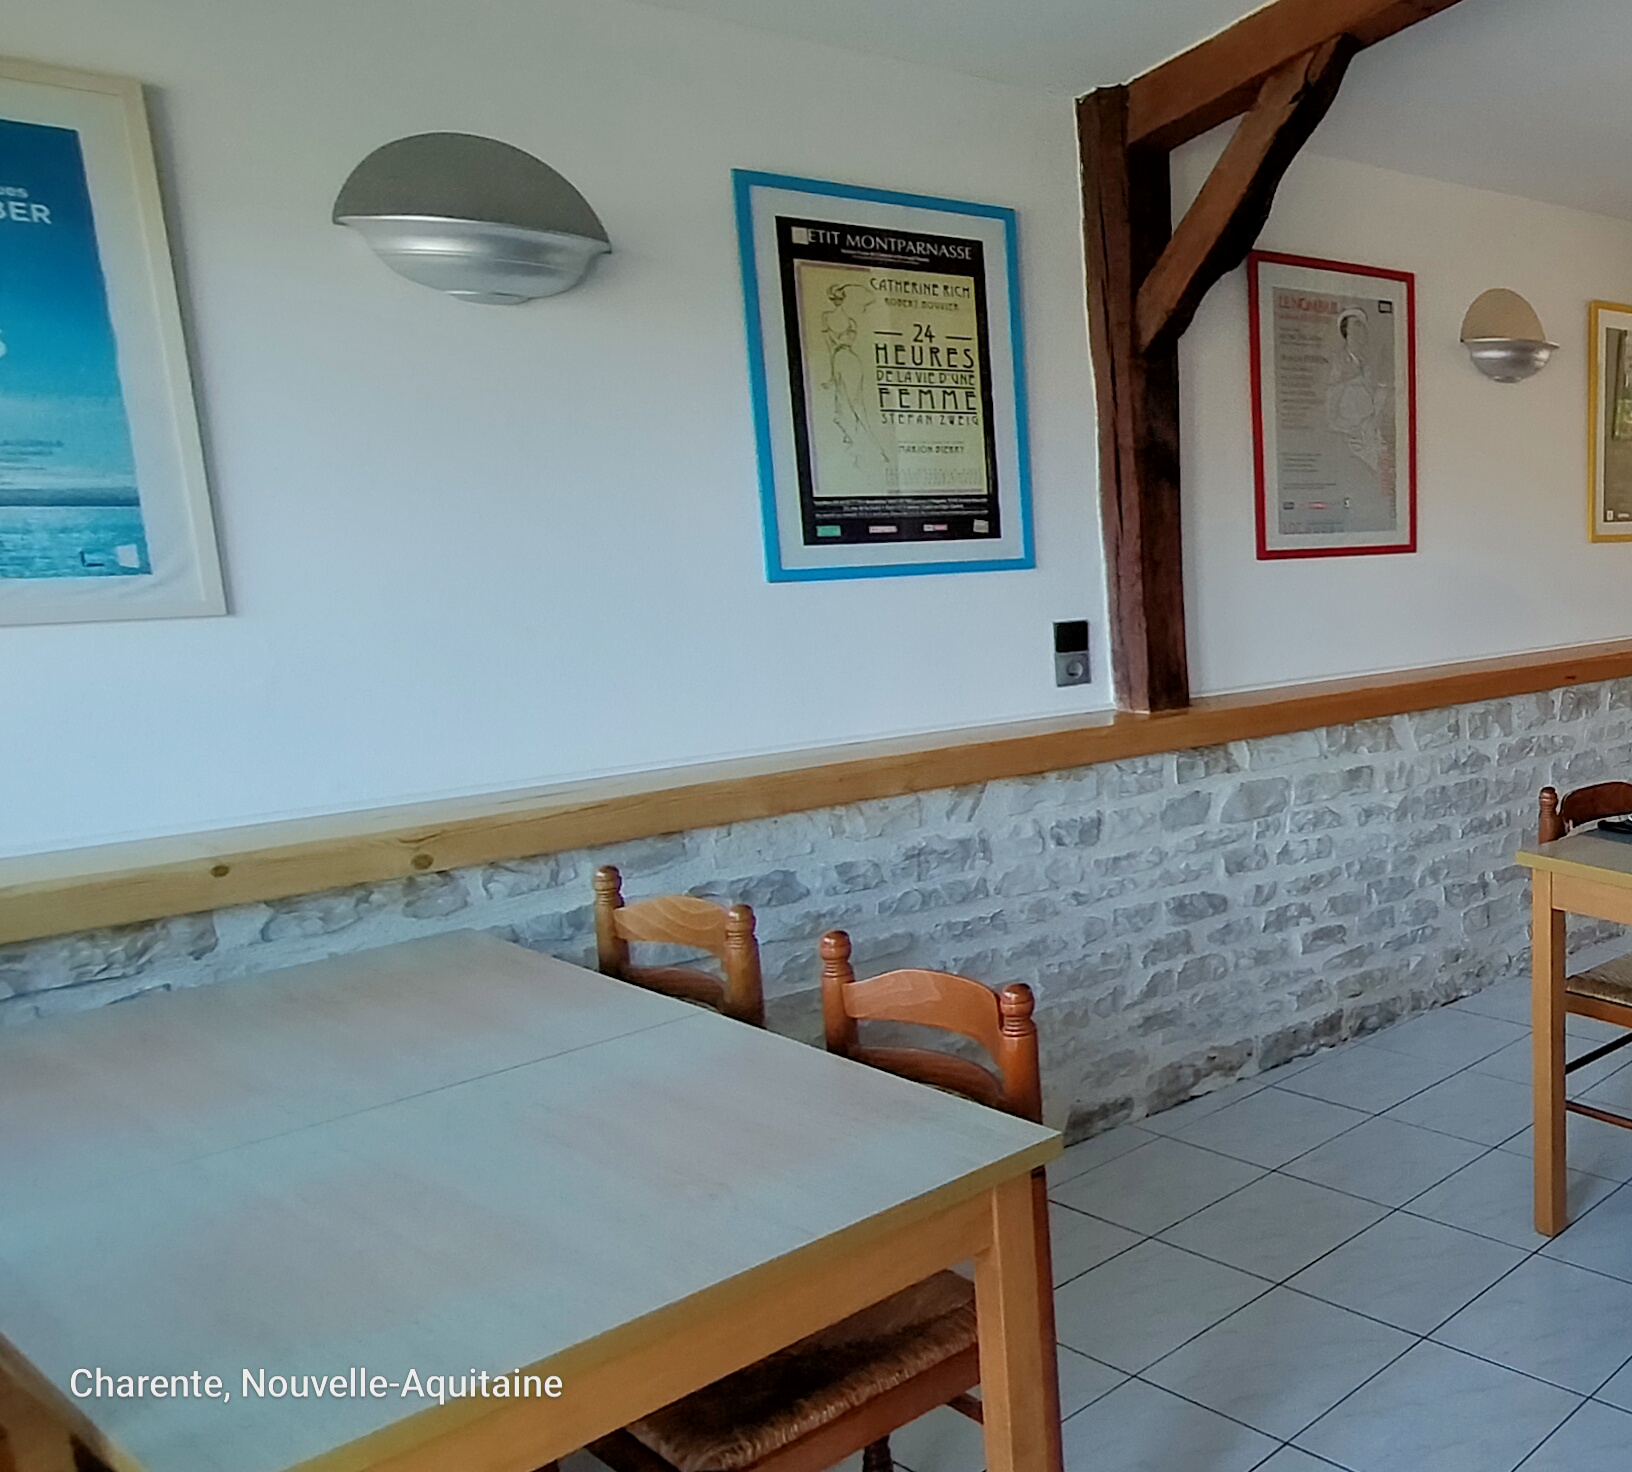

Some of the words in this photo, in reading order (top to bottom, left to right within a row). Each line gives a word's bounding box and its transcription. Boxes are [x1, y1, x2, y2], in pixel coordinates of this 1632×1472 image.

[846, 233, 972, 261] MONTPARNASSE
[870, 277, 939, 297] CATHERINE
[943, 284, 970, 299] RICH
[913, 323, 936, 343] 24
[875, 343, 975, 369] HEURES
[876, 369, 893, 382] DE
[896, 370, 912, 383] LA
[915, 371, 935, 384] VIE
[939, 372, 976, 386] D'UNE
[878, 387, 977, 411] FEMME
[881, 413, 933, 425] STEFAN
[939, 415, 979, 426] ZWEIG
